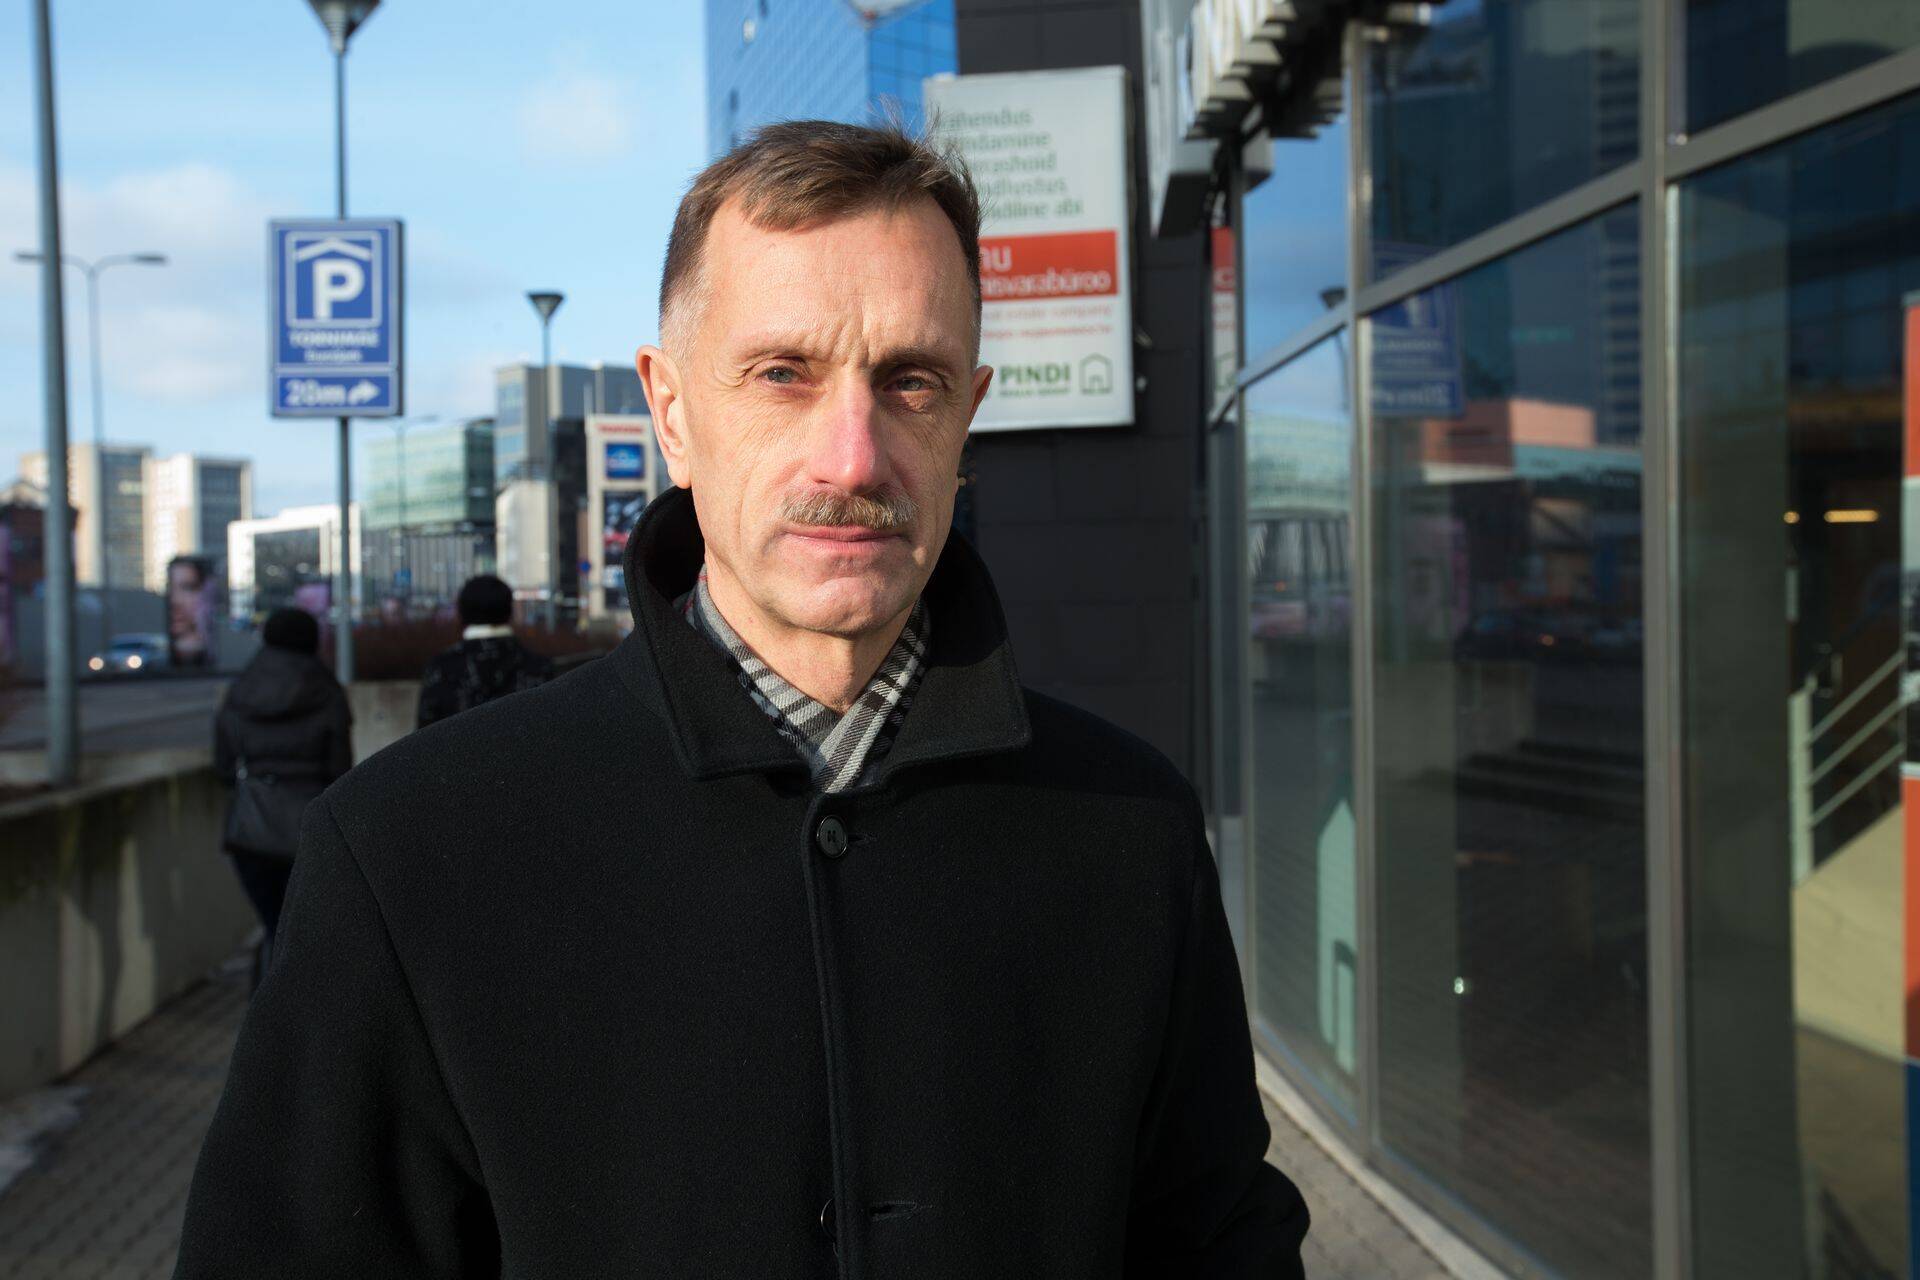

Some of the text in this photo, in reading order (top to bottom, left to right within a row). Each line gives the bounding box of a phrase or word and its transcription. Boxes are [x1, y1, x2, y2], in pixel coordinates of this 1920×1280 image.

[980, 246, 1012, 273] nu
[314, 258, 364, 320] P
[1000, 363, 1071, 384] PINDI
